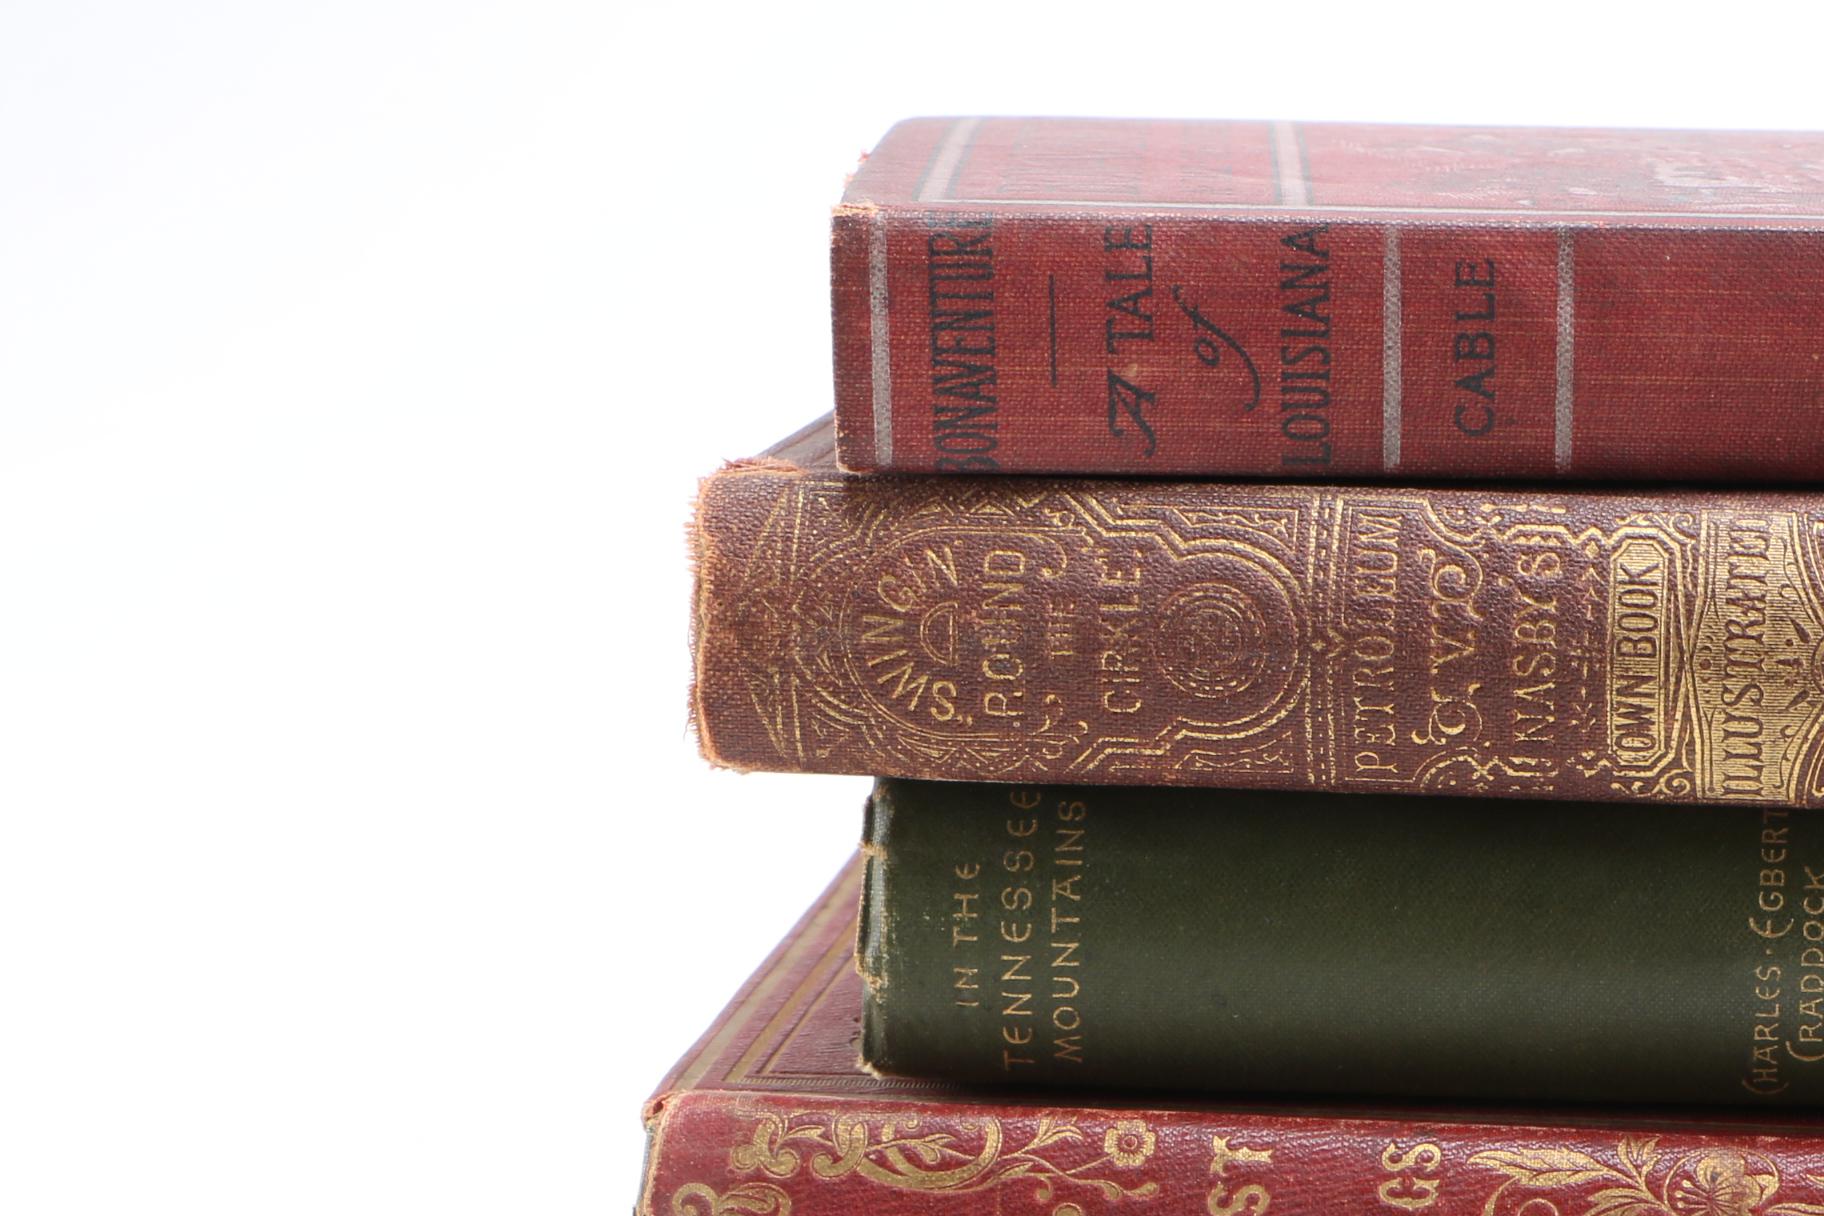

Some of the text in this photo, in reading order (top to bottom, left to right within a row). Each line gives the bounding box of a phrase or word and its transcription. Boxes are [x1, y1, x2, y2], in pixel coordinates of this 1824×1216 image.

[928, 212, 999, 474] BONAVENTURE
[1105, 223, 1156, 458] A TALE
[1171, 285, 1260, 412] of
[1279, 225, 1331, 465] LOUISIANA
[1455, 258, 1496, 436] CABLE
[1048, 593, 1075, 660] THE
[1352, 514, 1402, 774] PETROLEUM
[1498, 553, 1561, 745] NASBY'S
[1618, 562, 1660, 753] OWN BOOK
[952, 862, 981, 1007] IN THE
[1000, 791, 1041, 1071] TENNESSEE
[1051, 800, 1088, 1063] MOUNTAINS
